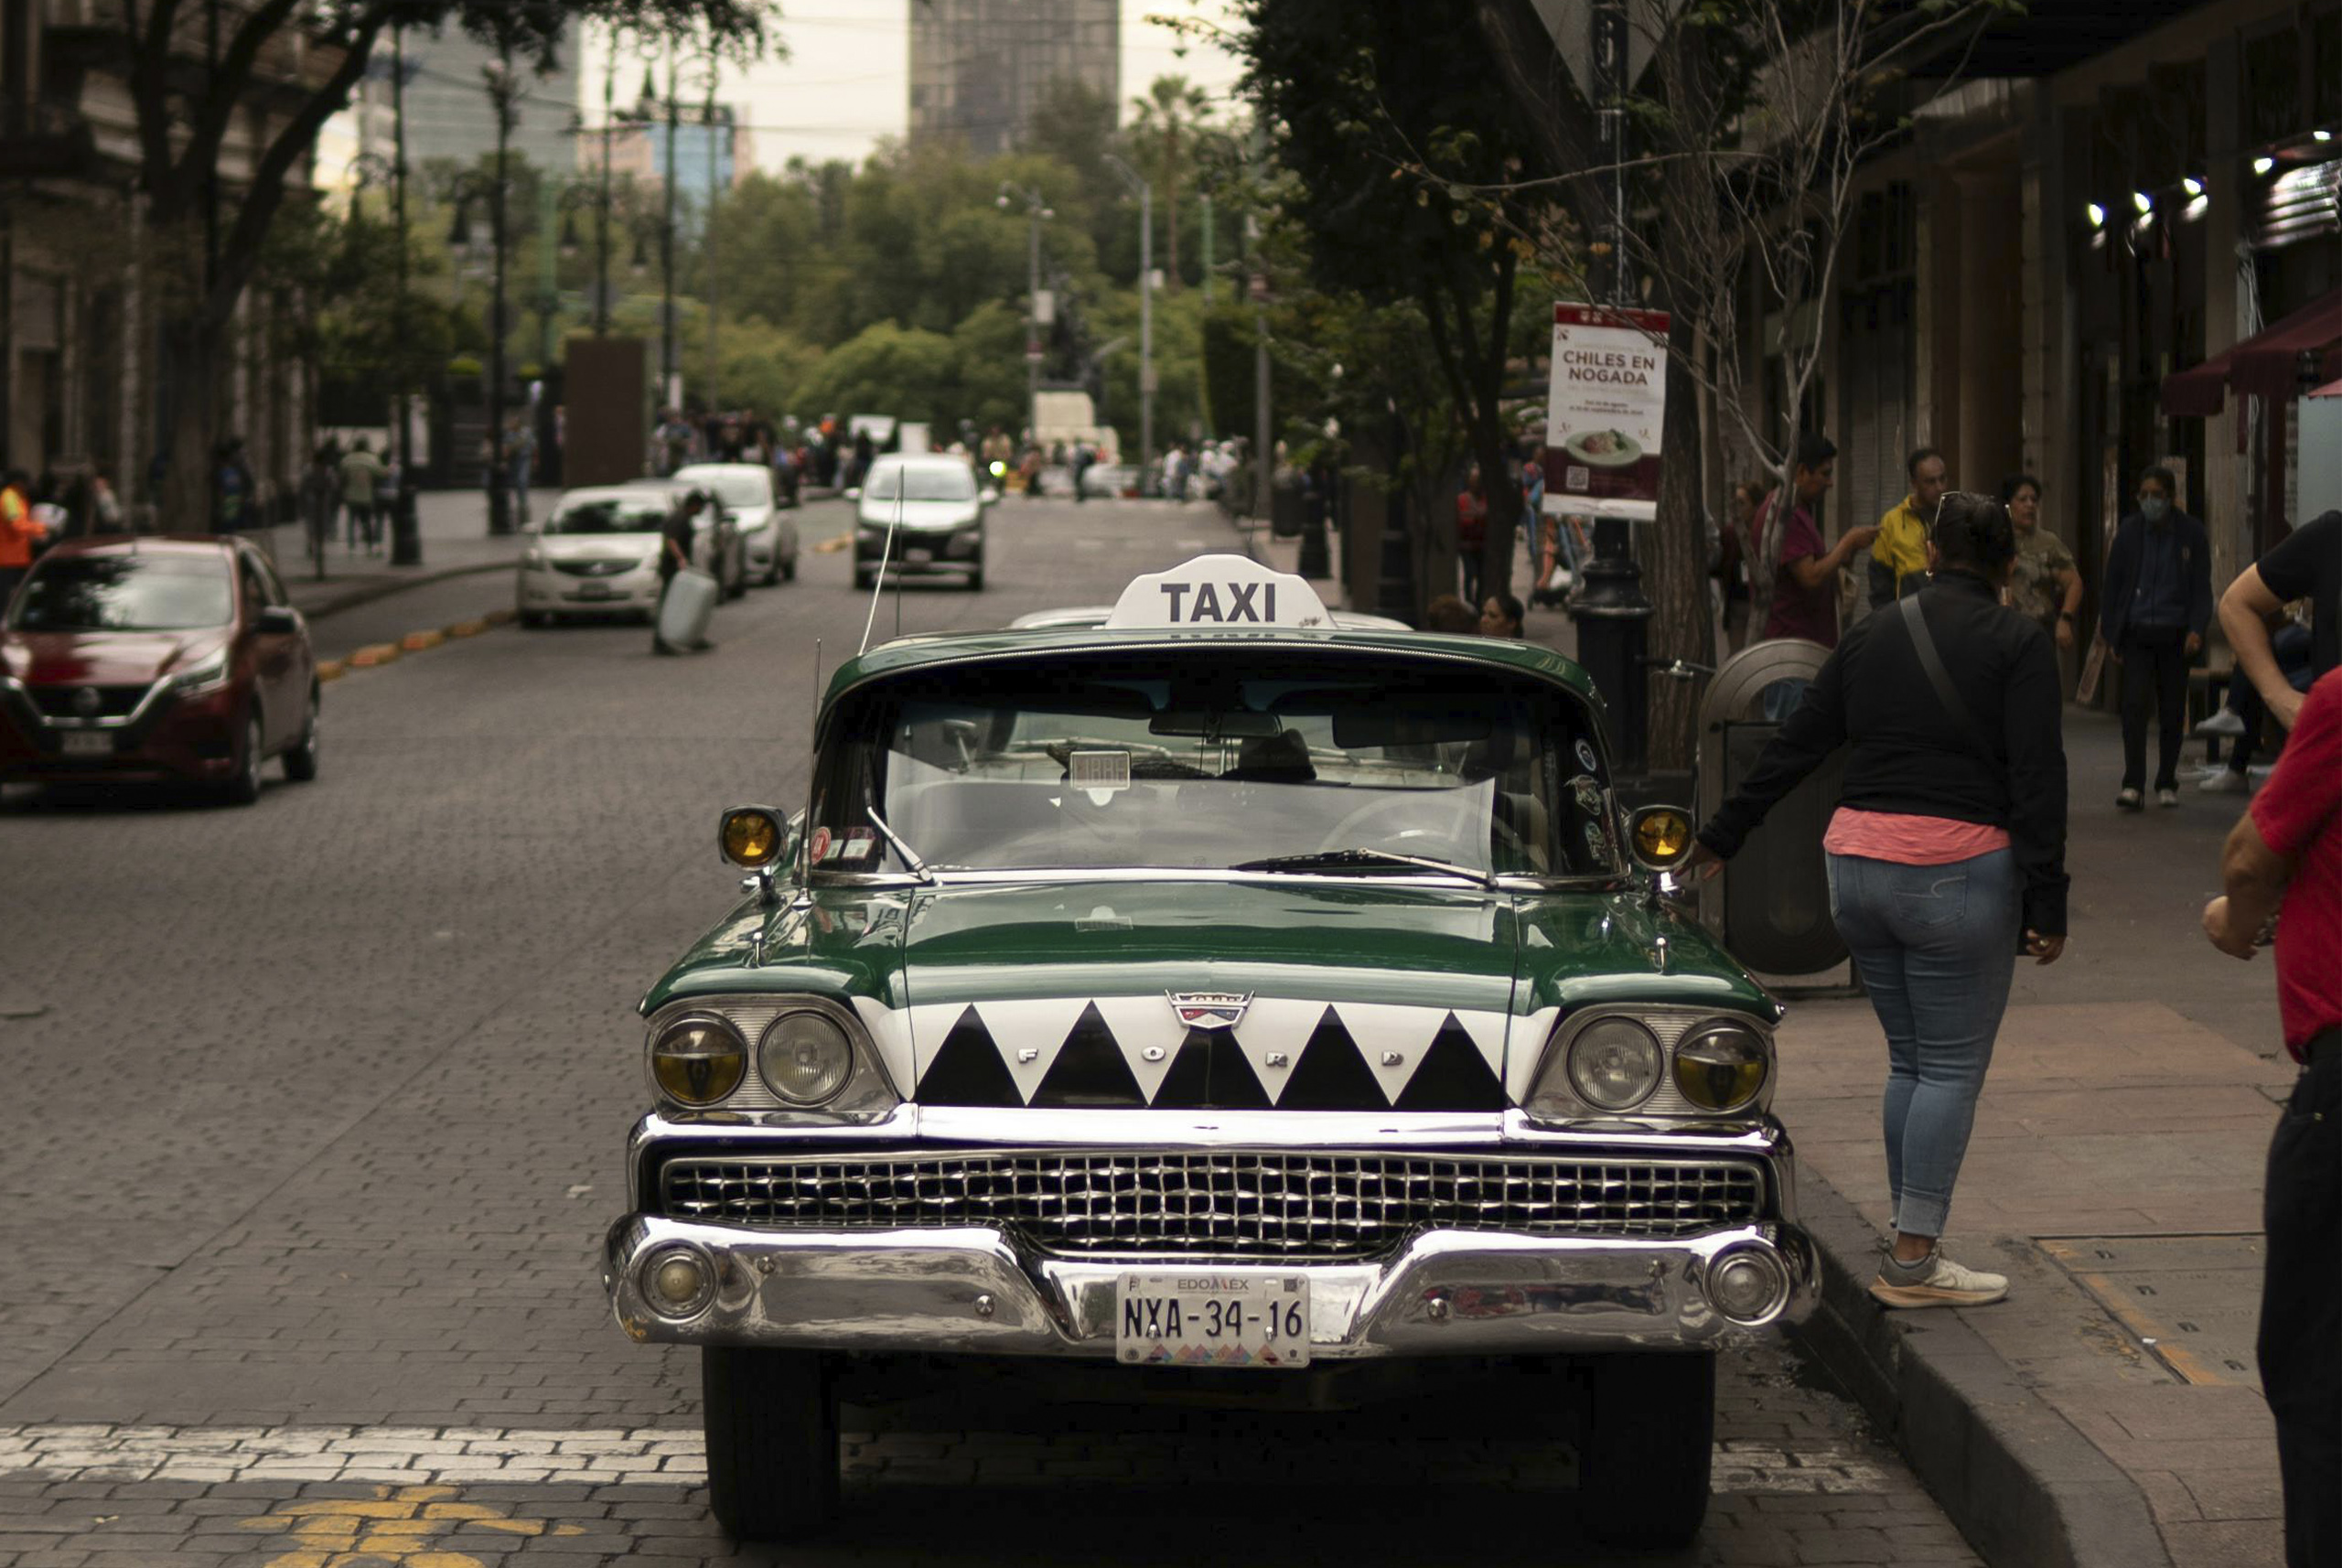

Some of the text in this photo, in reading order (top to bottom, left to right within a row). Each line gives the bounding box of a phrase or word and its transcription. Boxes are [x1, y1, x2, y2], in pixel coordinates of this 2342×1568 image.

[1563, 350, 1655, 371] CHILES EN
[1569, 367, 1648, 385] NOGADA
[1161, 583, 1275, 622] TAXI
[1123, 1298, 1303, 1337] NXA-34-16
